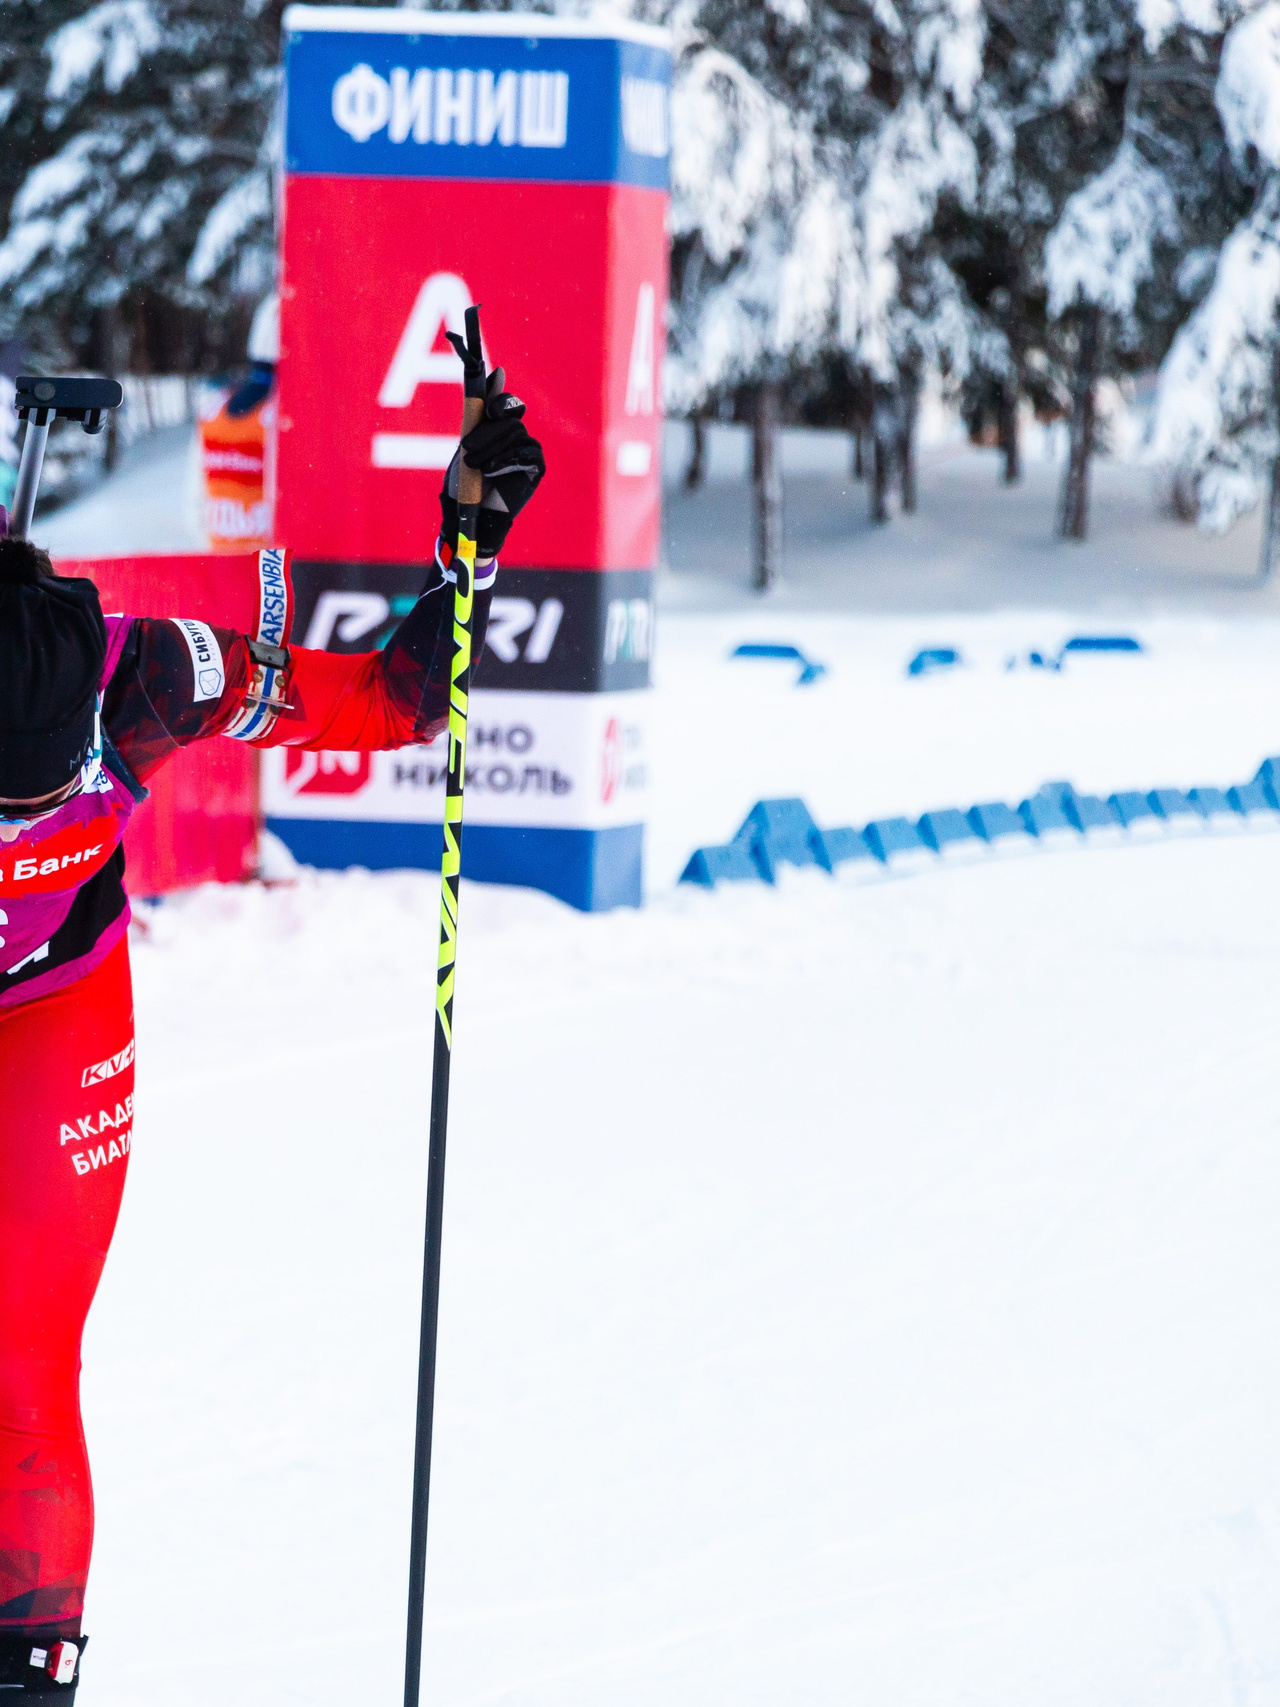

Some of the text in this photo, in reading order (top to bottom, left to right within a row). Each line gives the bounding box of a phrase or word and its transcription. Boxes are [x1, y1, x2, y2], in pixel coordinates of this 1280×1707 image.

[332, 63, 569, 148] ФИНИШ
[303, 591, 564, 664] PRI
[13, 843, 104, 881] Банк
